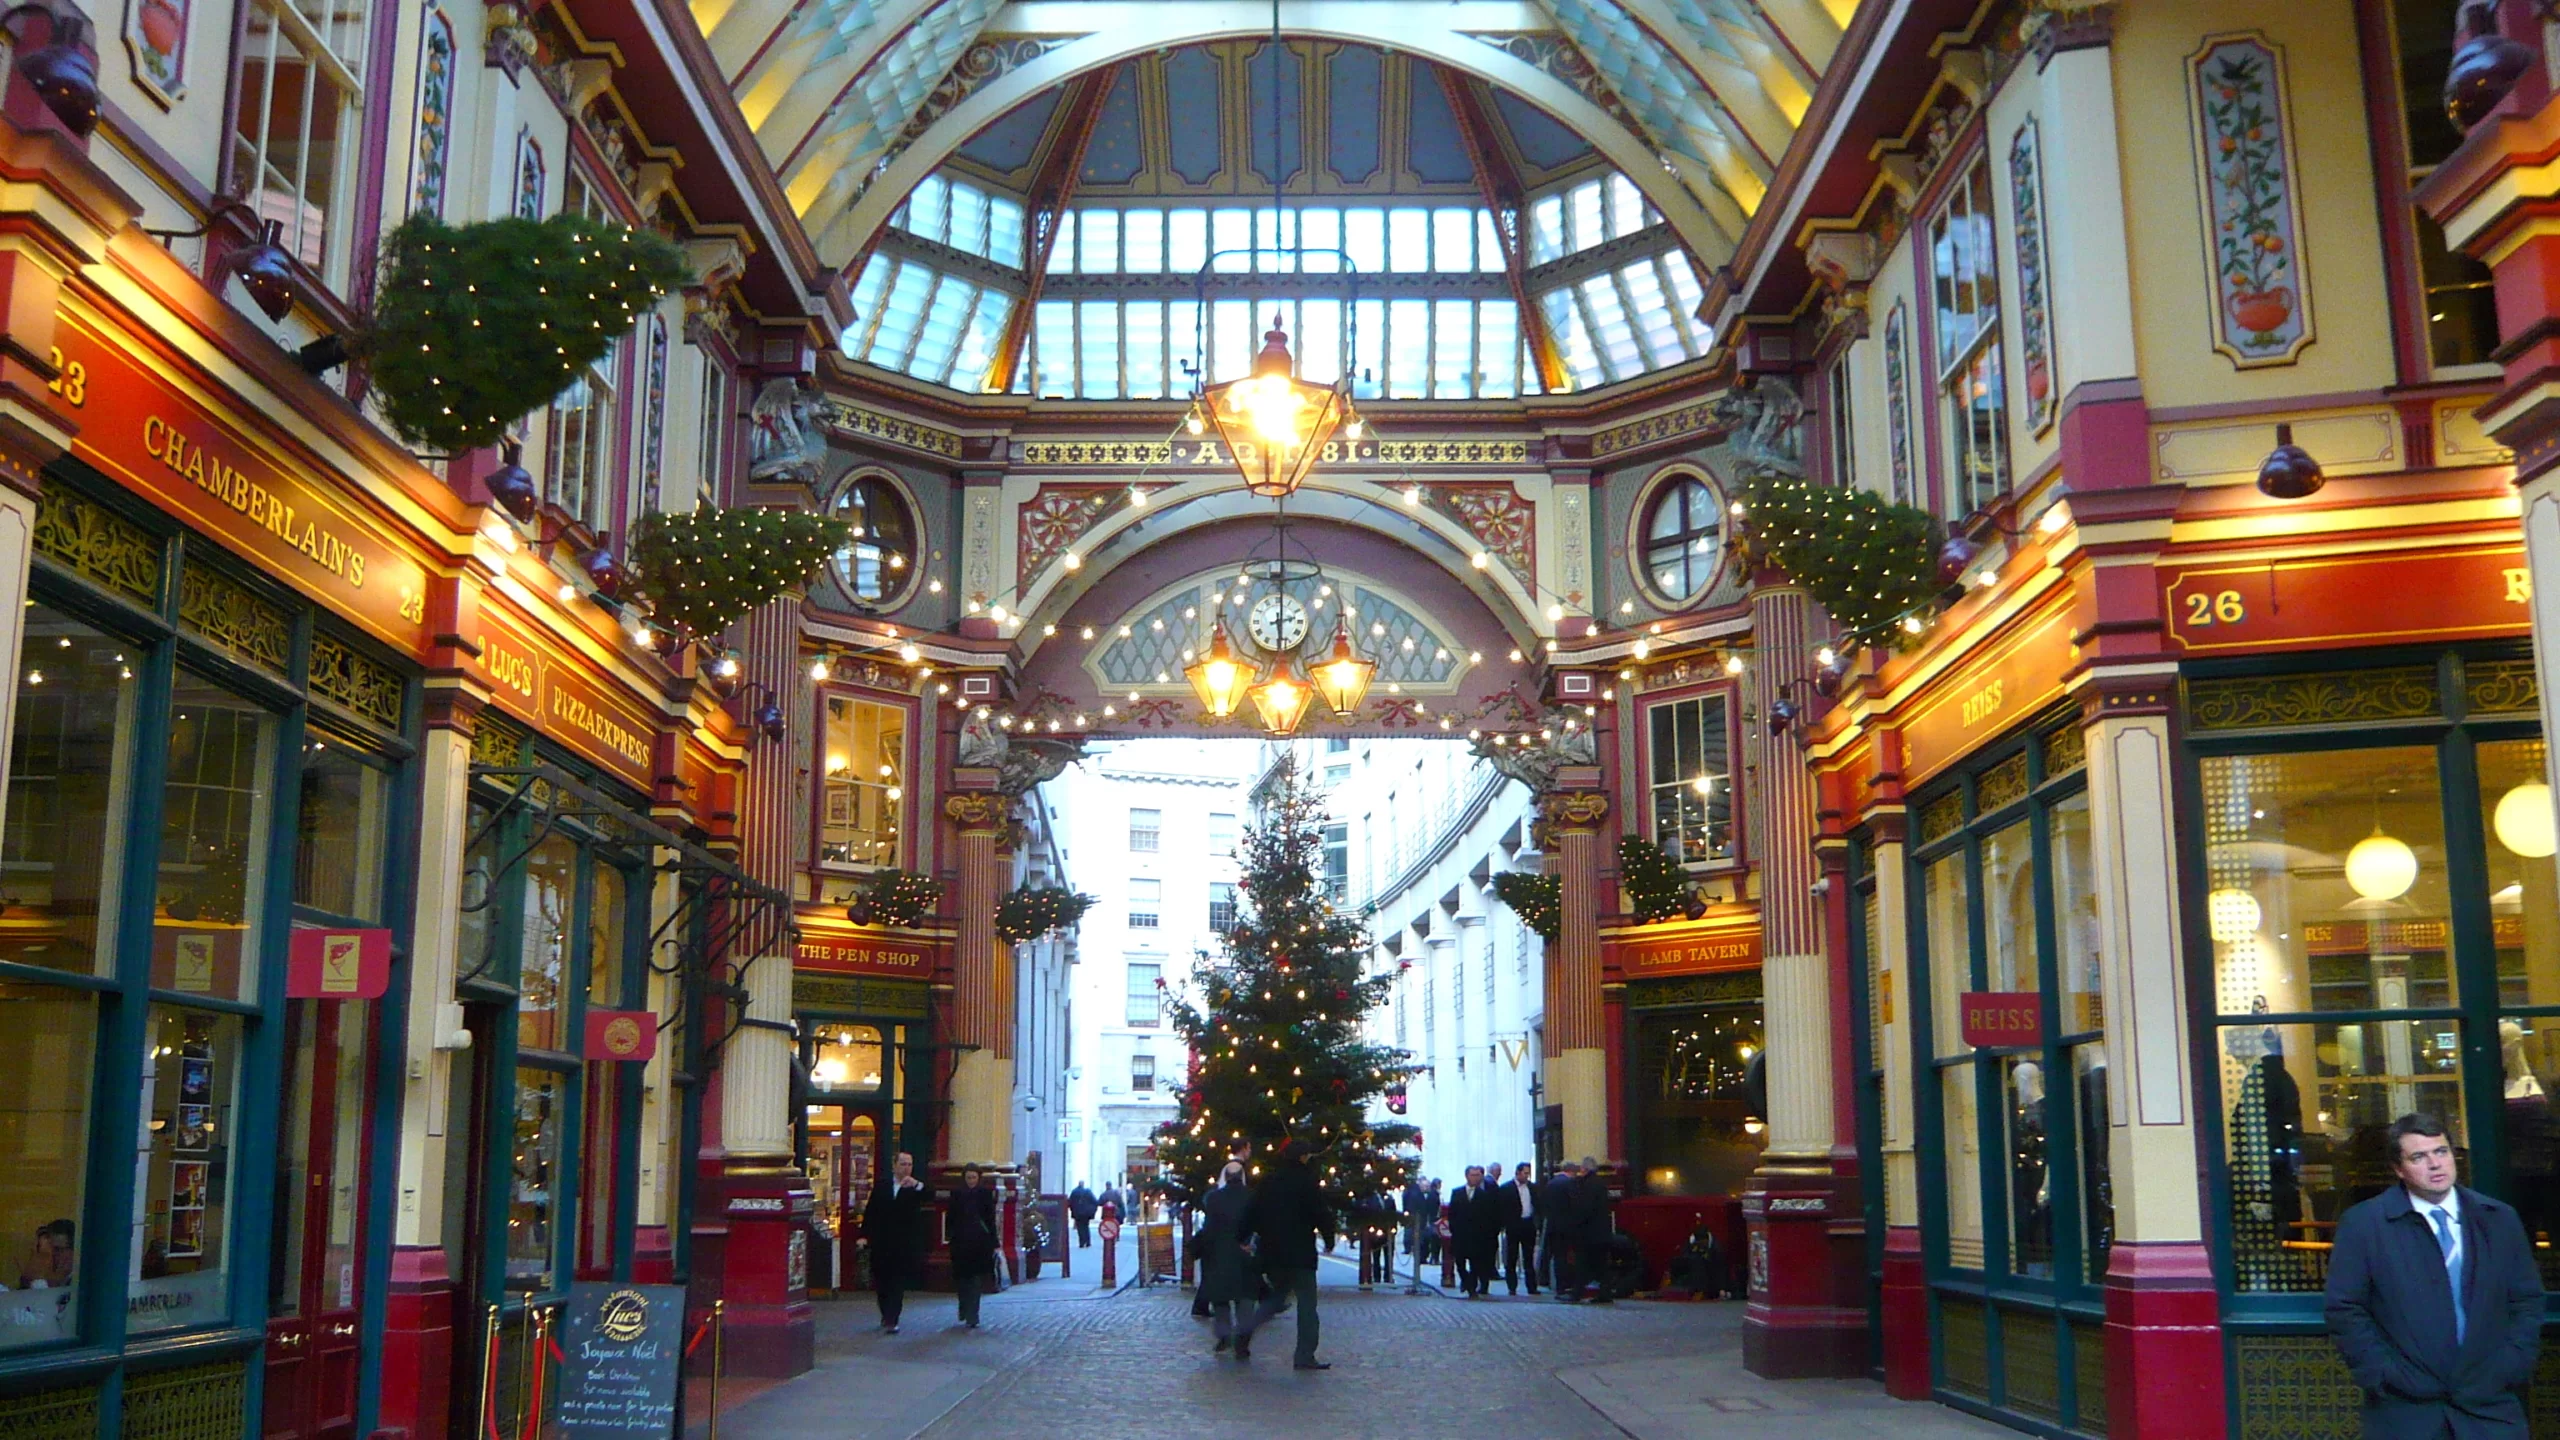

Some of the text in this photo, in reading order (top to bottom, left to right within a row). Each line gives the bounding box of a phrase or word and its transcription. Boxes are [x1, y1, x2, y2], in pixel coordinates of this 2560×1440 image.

[144, 415, 365, 587] CHAMBERLAIN'S
[400, 586, 425, 625] 23
[2186, 590, 2244, 625] 26
[490, 643, 532, 697] LUC'S
[1962, 679, 2004, 728] REISS
[553, 685, 650, 768] PIZZAEXPRESS
[799, 944, 920, 967] THE PEN SHOP
[1640, 943, 1749, 966] LAMB TAVERN
[1969, 1008, 2036, 1031] REISS
[580, 1340, 625, 1367] Joyeux
